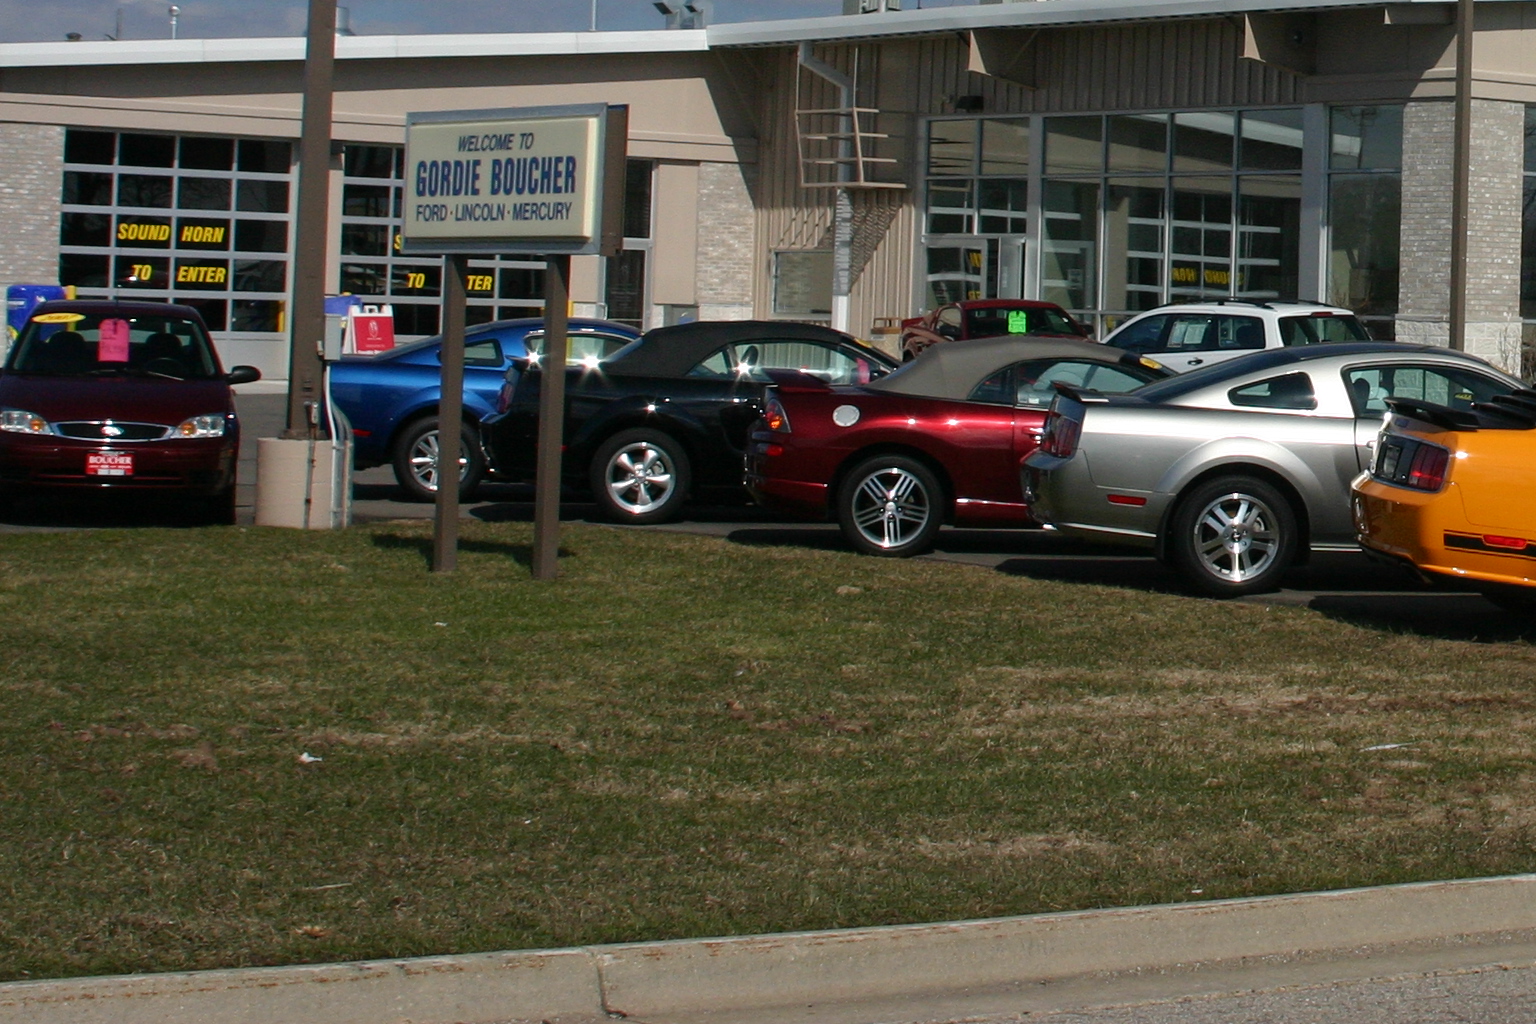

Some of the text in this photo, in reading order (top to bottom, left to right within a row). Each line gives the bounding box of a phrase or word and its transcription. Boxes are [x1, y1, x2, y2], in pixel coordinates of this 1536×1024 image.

[458, 132, 535, 152] WELCOME TO
[416, 155, 577, 197] GORDIE BOUCHER
[416, 202, 573, 222] FORD LINCOLN MERCURY
[117, 222, 225, 243] SOUND HORN
[131, 264, 226, 283] TO ENTER
[407, 272, 493, 291] TO TER
[89, 456, 132, 464] BOUCHER
